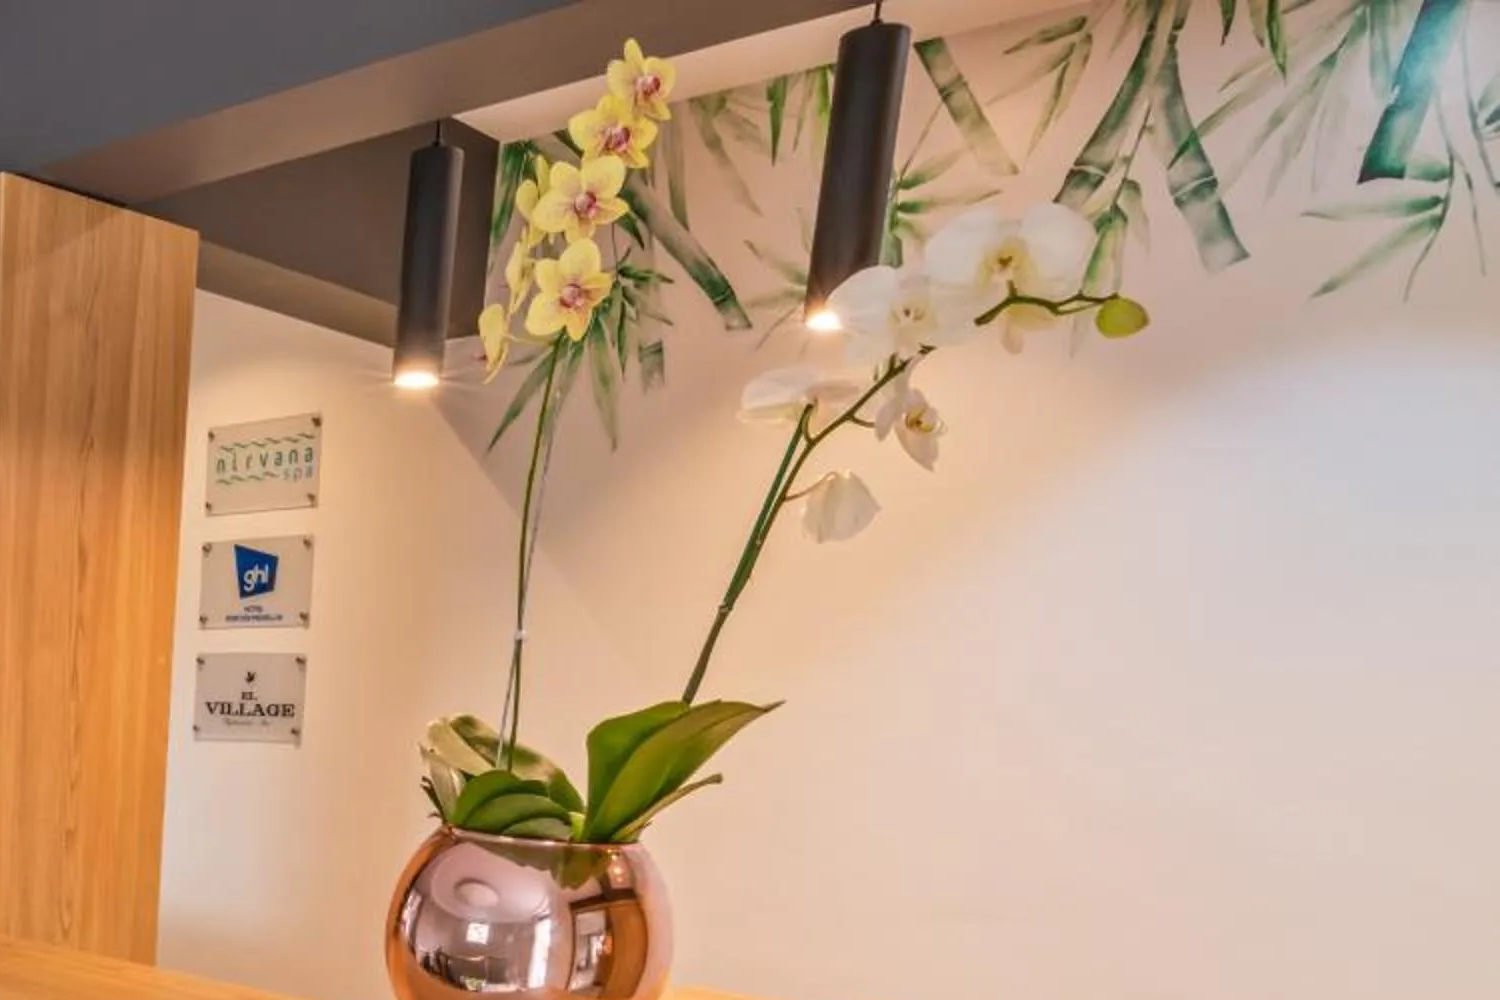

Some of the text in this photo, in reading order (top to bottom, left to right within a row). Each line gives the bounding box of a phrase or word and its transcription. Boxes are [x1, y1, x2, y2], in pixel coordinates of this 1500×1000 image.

[216, 447, 313, 474] nirvana
[284, 466, 313, 482] spa
[205, 701, 296, 718] VILLAGE
